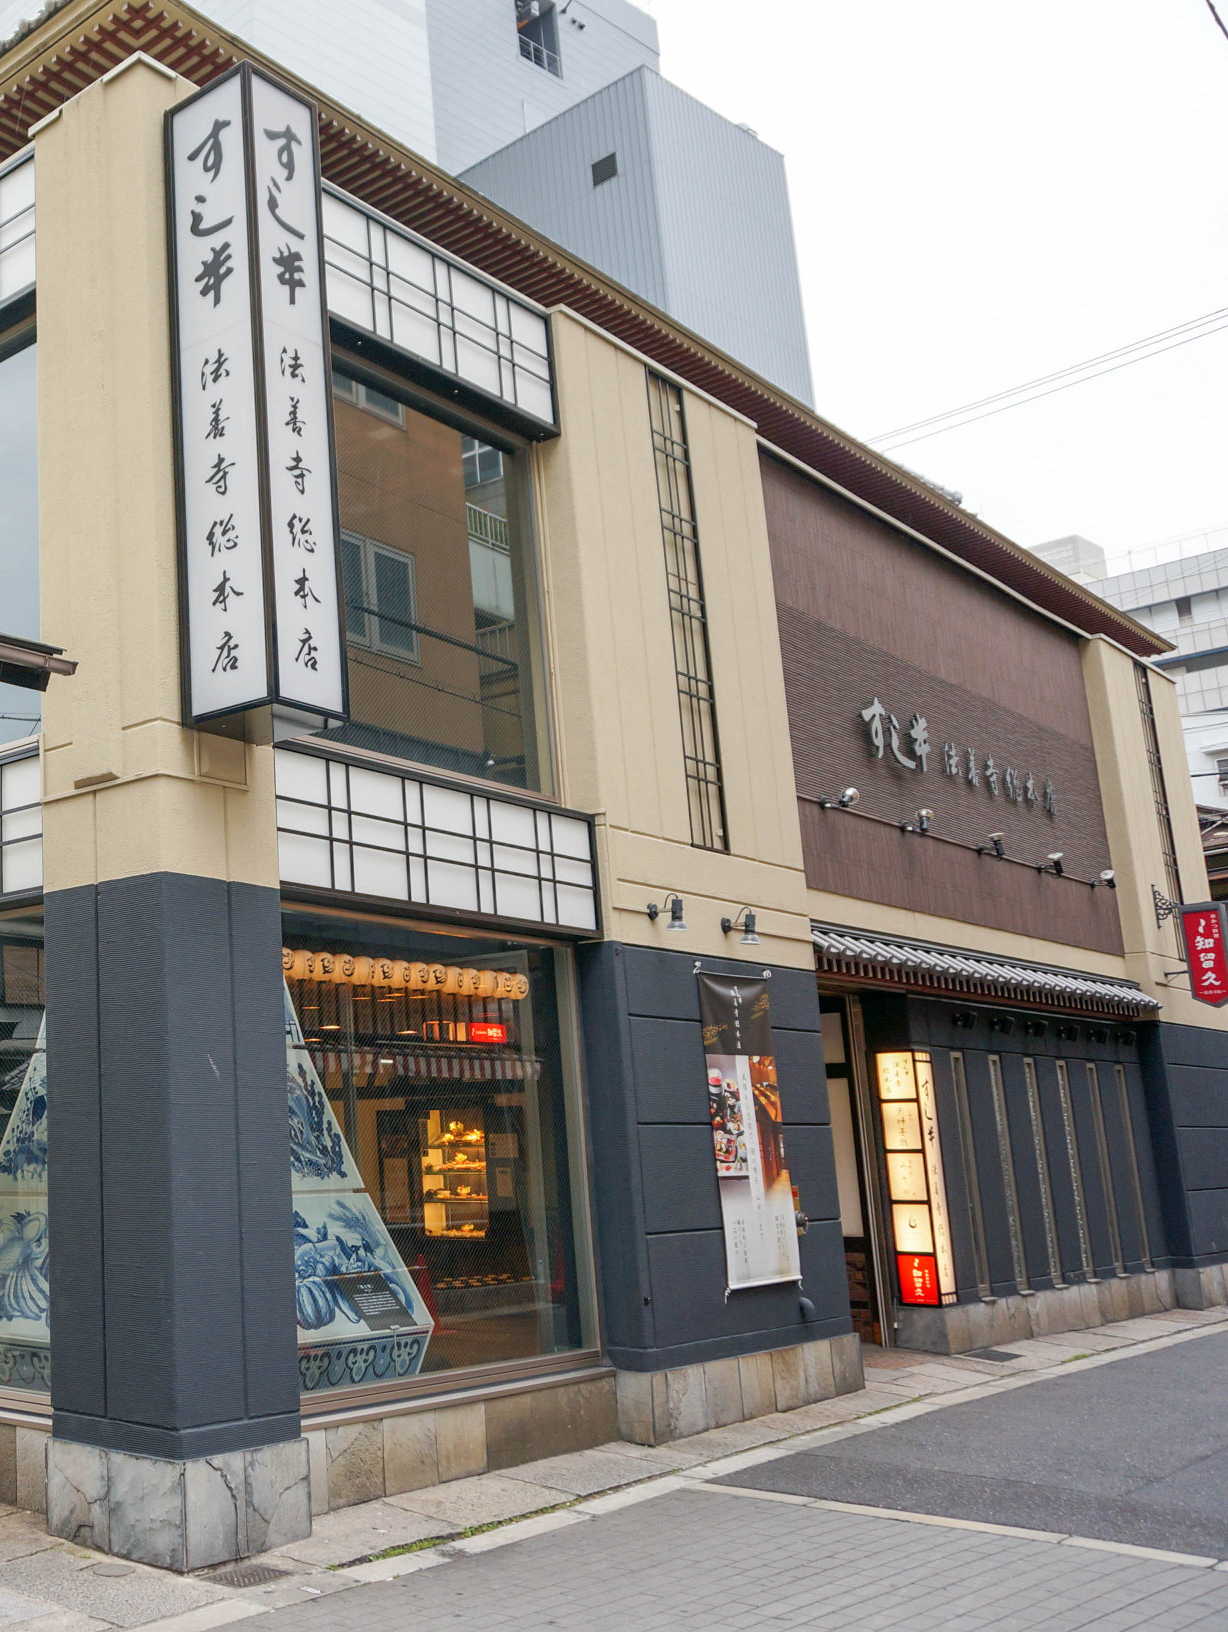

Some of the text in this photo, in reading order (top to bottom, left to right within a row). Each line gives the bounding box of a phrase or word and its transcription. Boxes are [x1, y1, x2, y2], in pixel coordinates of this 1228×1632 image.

[187, 119, 244, 674] すし半 法善寺総本店
[263, 124, 321, 673] すし半 法善寺総本店
[862, 697, 1058, 817] すし半 法善寺総本店
[922, 1080, 936, 1148] すし半
